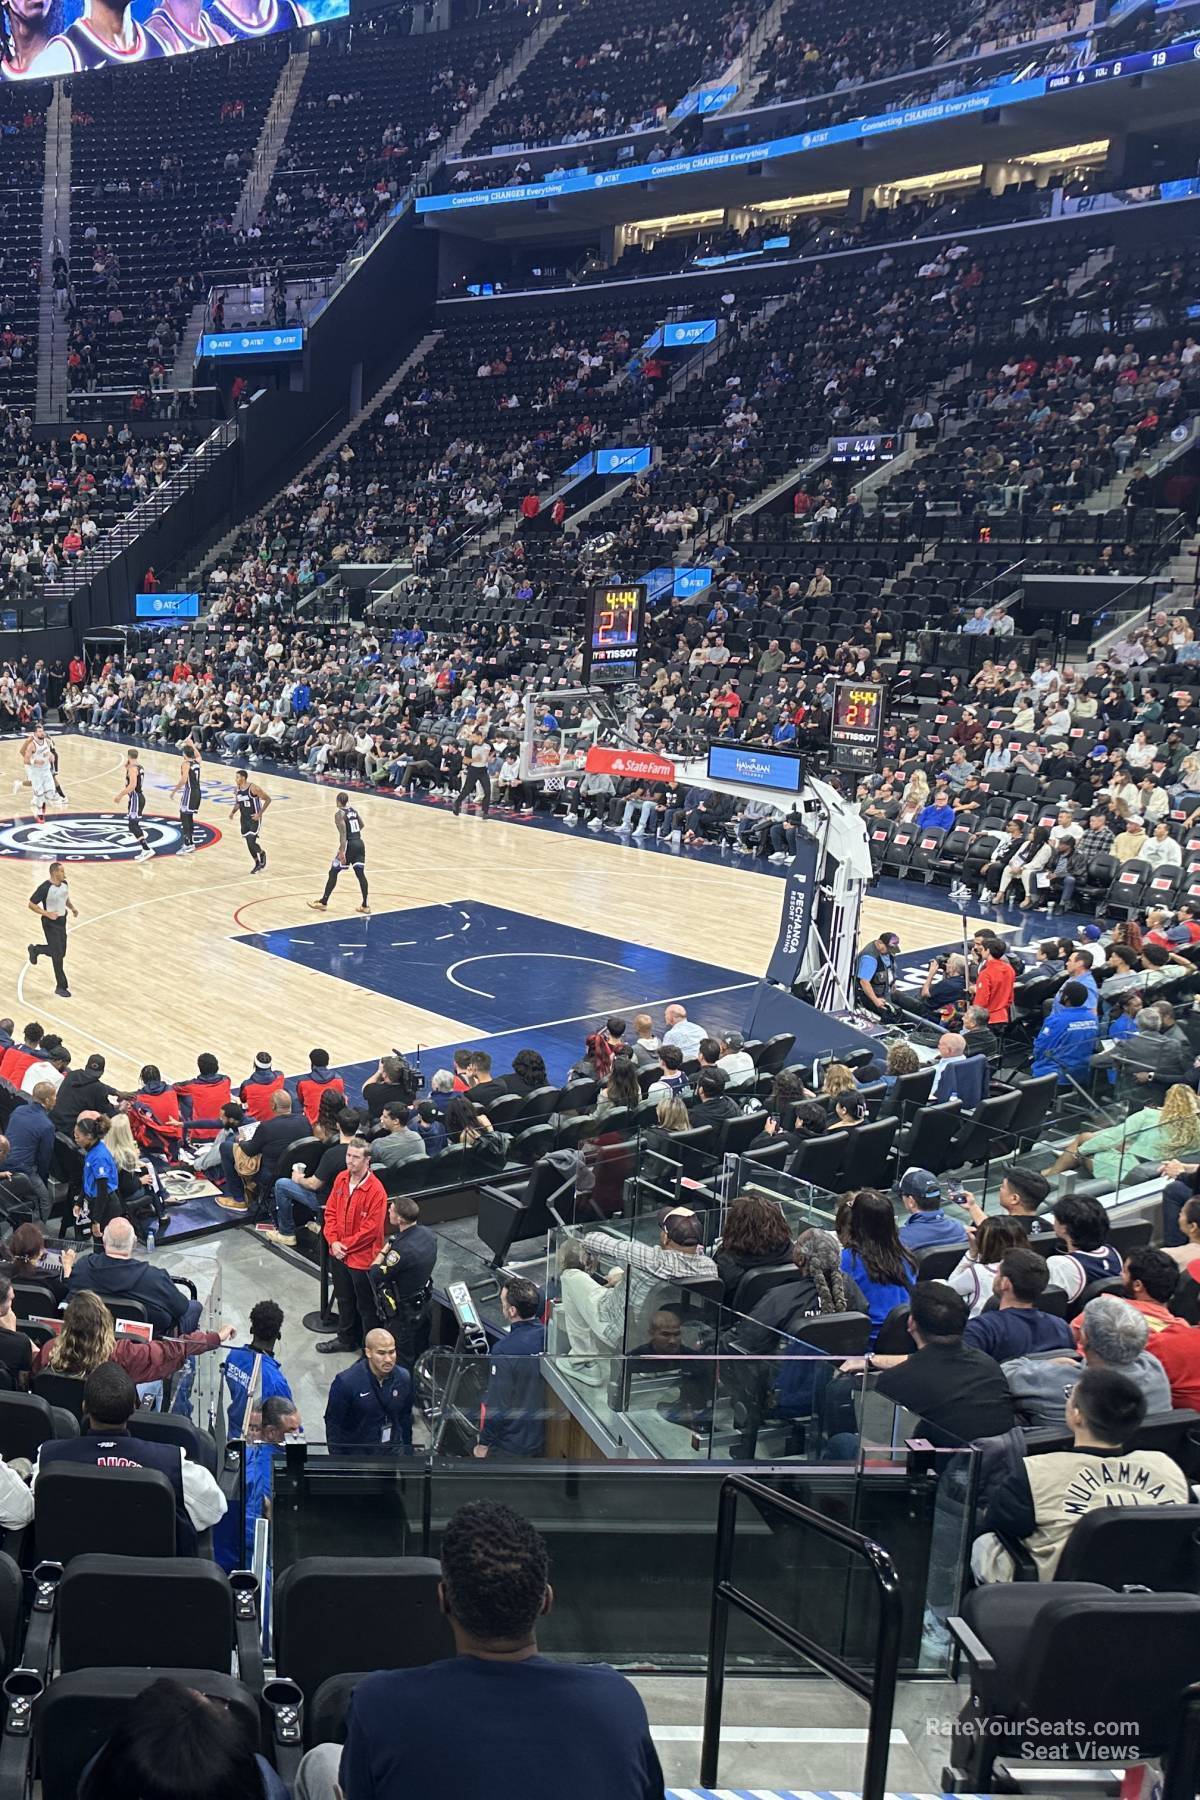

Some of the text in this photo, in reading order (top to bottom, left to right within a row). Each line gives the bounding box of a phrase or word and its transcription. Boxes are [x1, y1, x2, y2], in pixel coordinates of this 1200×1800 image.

[1152, 52, 1166, 66] 19
[651, 146, 769, 175] Connecting CHANGES Everything
[603, 173, 620, 183] AT&T
[452, 183, 562, 205] Connecting CHANGES Everything
[218, 340, 232, 348] AT&T
[250, 338, 264, 346] AT&T
[282, 336, 296, 344] AT&T
[854, 440, 876, 452] 4:44
[606, 592, 637, 610] 4:44
[599, 610, 633, 643] 21
[606, 648, 638, 659] TISSOT
[847, 705, 870, 725] 21
[846, 732, 876, 743] TISSOT
[788, 891, 805, 953] PECHANGA
[228, 1362, 251, 1384] SECURI
